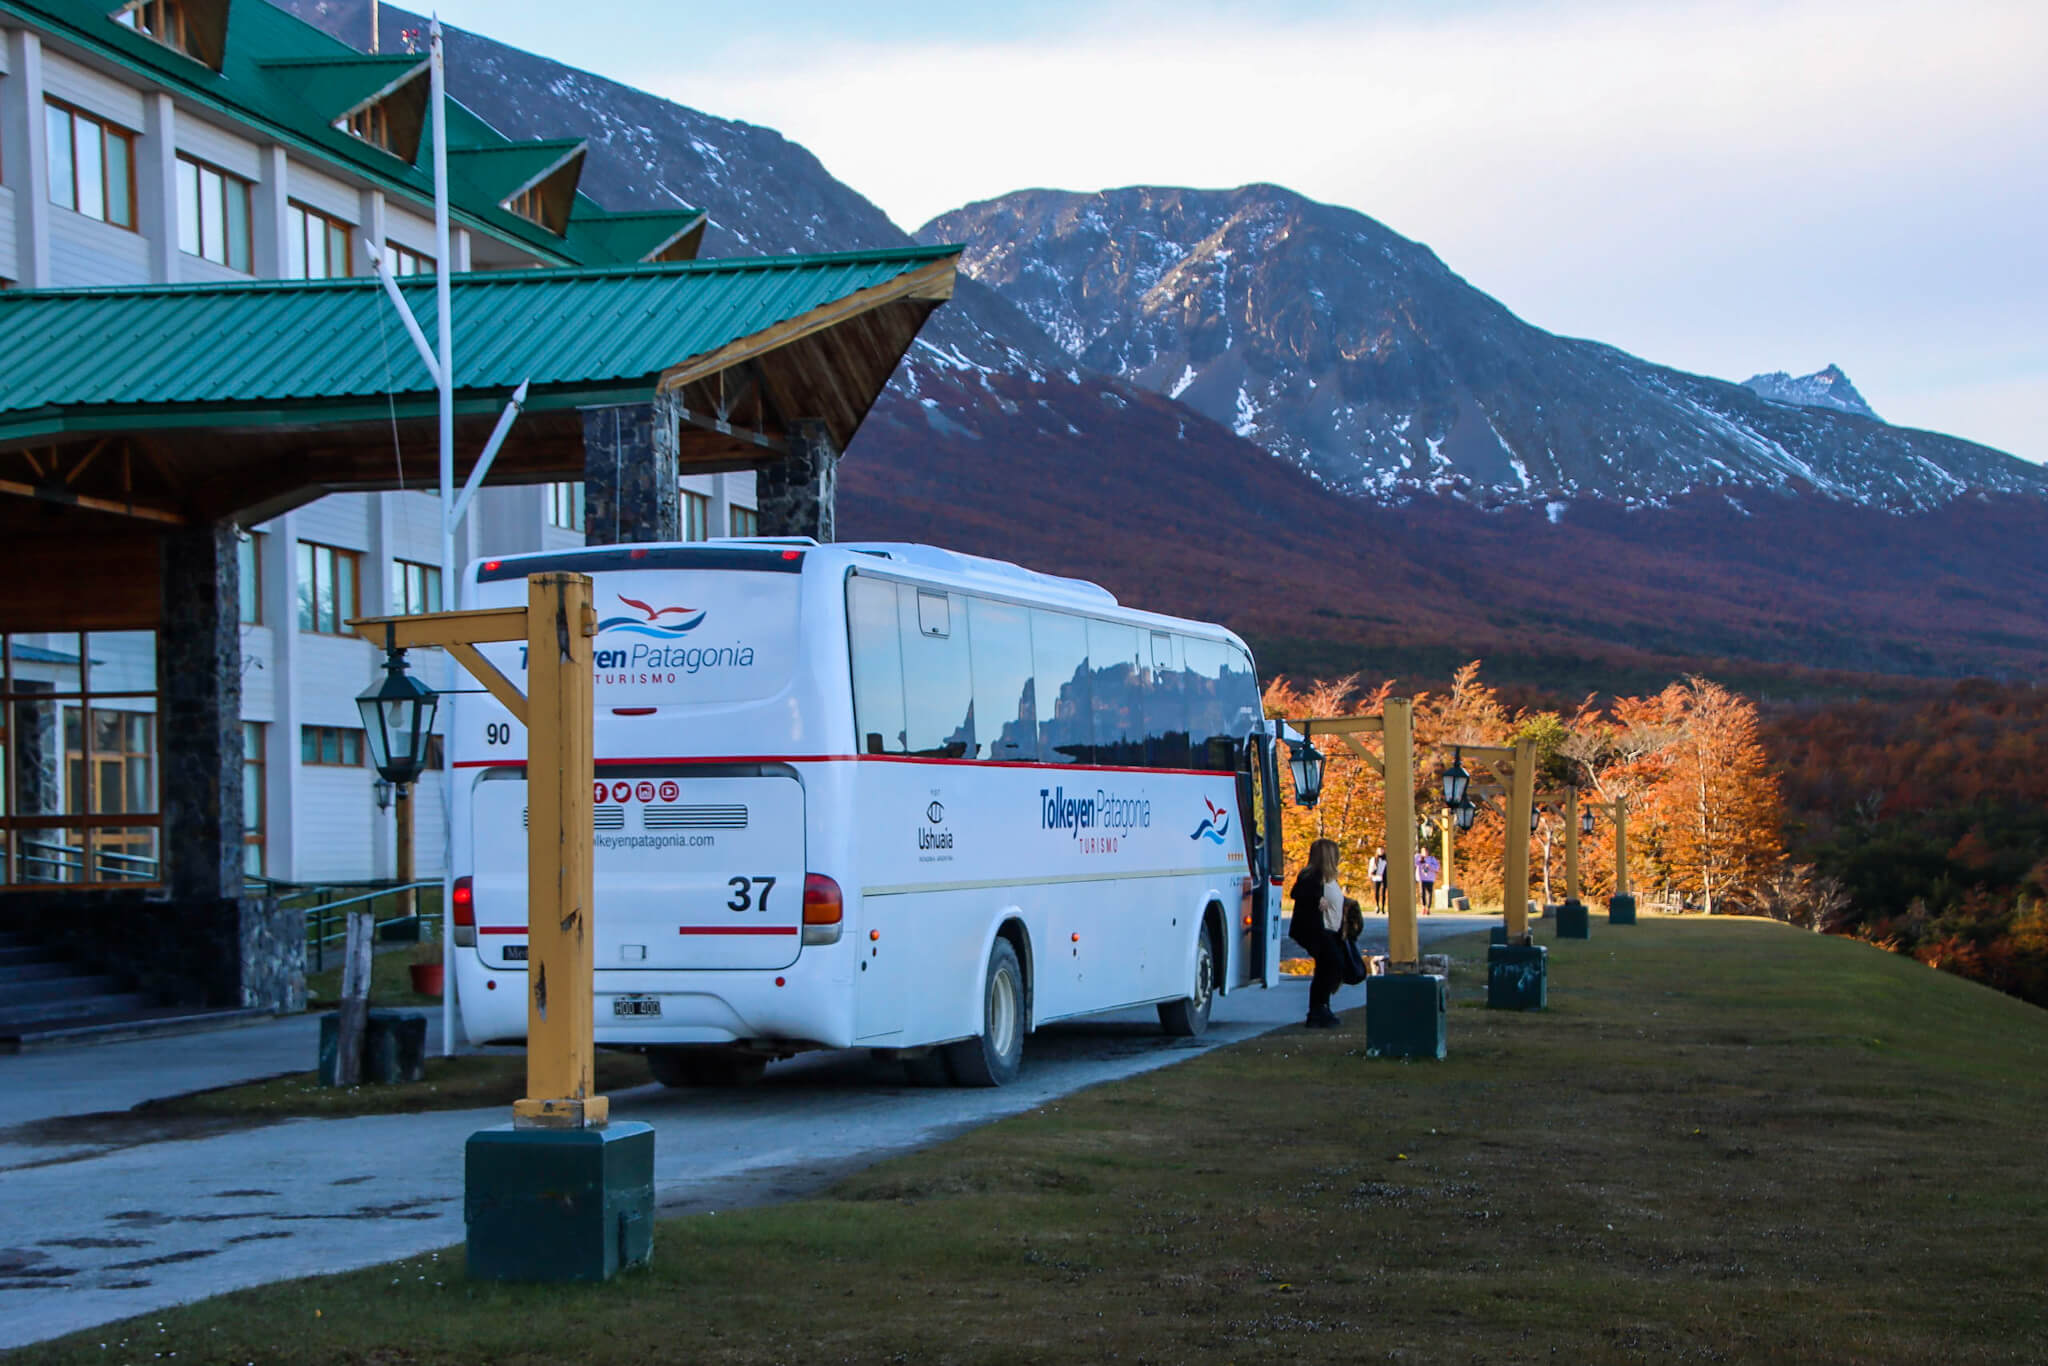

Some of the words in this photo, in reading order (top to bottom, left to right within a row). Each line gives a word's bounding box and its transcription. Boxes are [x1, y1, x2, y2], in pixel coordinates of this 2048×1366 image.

[631, 640, 754, 674] Patagonia
[595, 672, 676, 685] TURISMO
[487, 723, 510, 745] 90
[1040, 786, 1094, 840] Tolkeyen
[1096, 788, 1150, 838] Patagonia
[594, 833, 714, 850] lkeyenpatagonia.com
[918, 827, 953, 850] Ushuaia
[1080, 838, 1118, 854] TURISMO
[727, 876, 776, 912] 37
